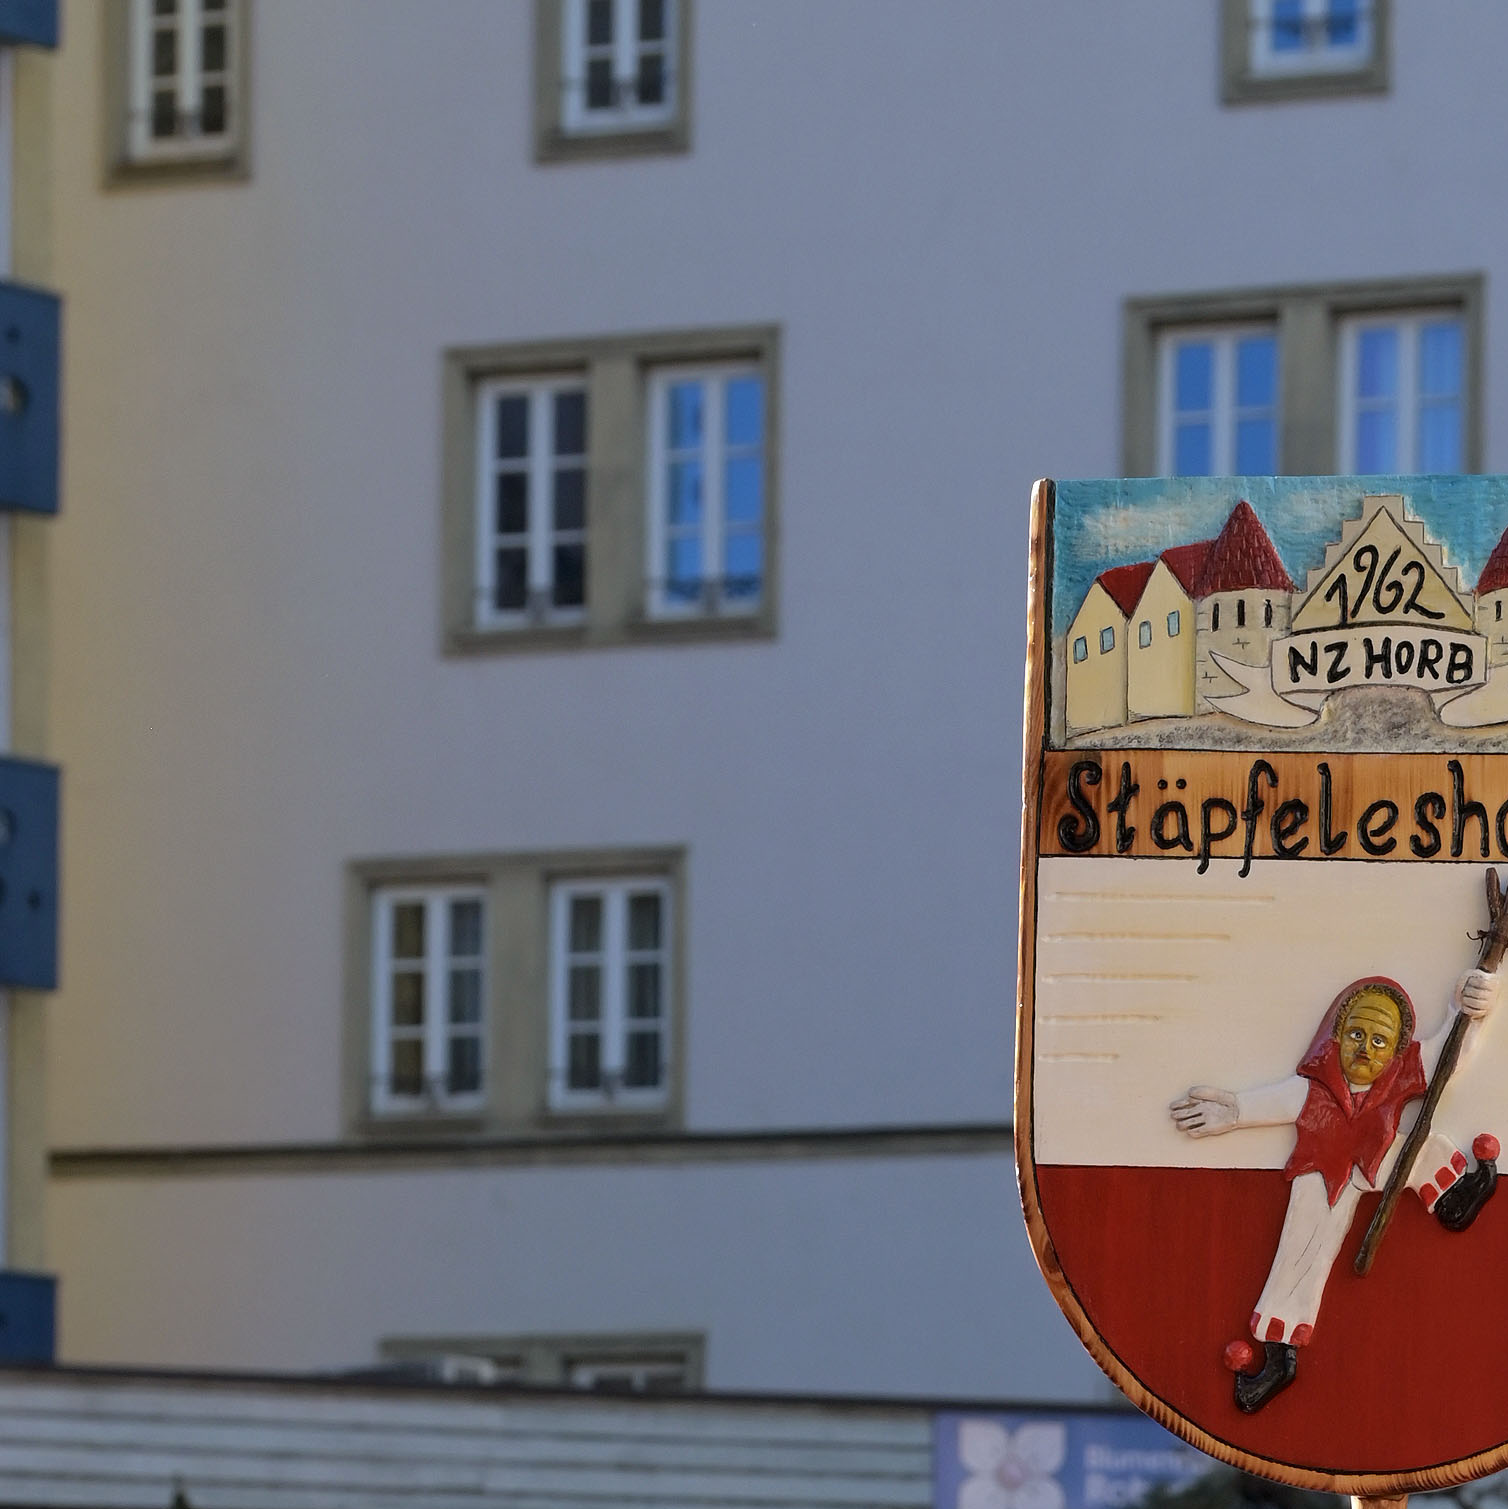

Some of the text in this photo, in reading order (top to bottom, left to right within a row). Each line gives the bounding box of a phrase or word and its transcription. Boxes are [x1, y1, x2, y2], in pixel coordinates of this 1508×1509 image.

[1324, 544, 1445, 625] 1962
[1288, 636, 1474, 684] NZ HORB
